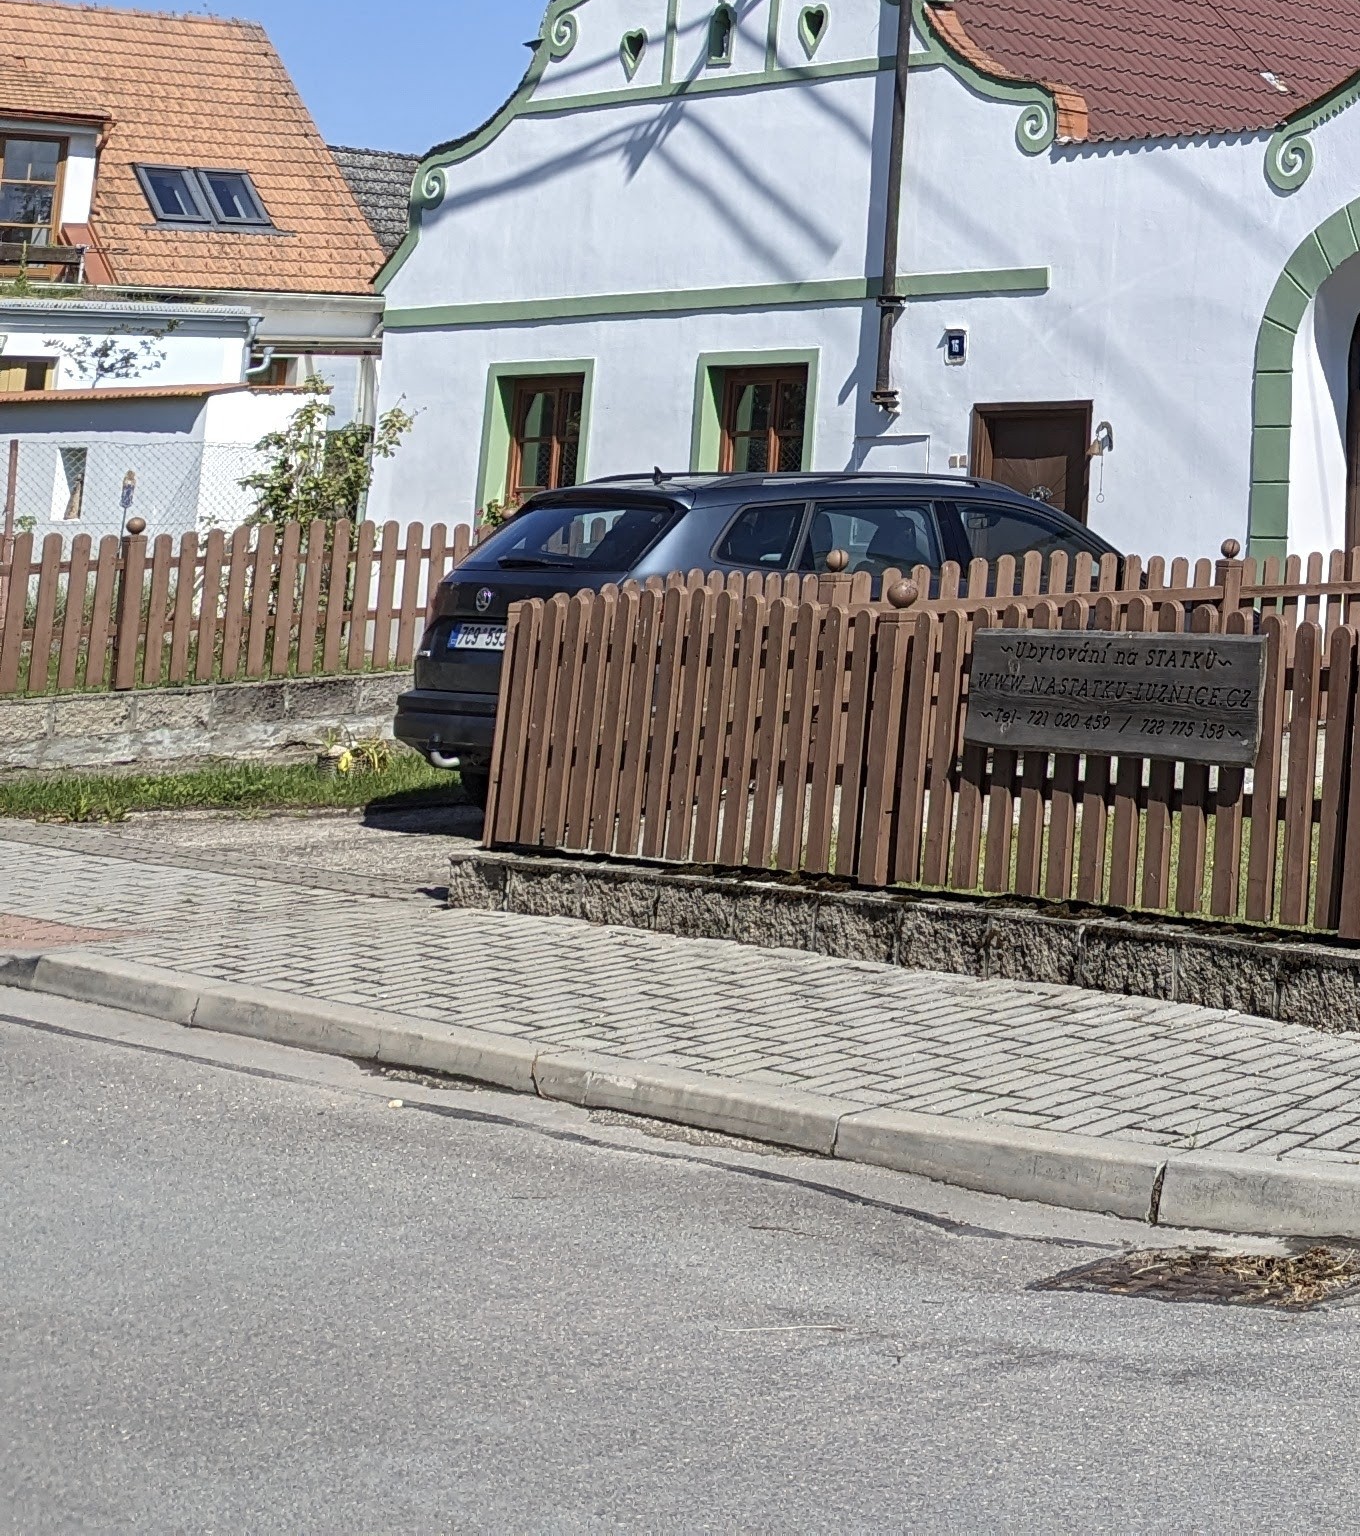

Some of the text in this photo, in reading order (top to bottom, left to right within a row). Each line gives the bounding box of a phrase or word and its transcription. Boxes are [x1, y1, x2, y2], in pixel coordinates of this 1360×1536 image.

[457, 626, 481, 645] 7C9
[1015, 641, 1218, 670] Ubytování na STATKU
[1027, 709, 1050, 726] 721
[1054, 712, 1080, 728] 020
[1083, 714, 1111, 730] 459
[1170, 720, 1196, 738] 775
